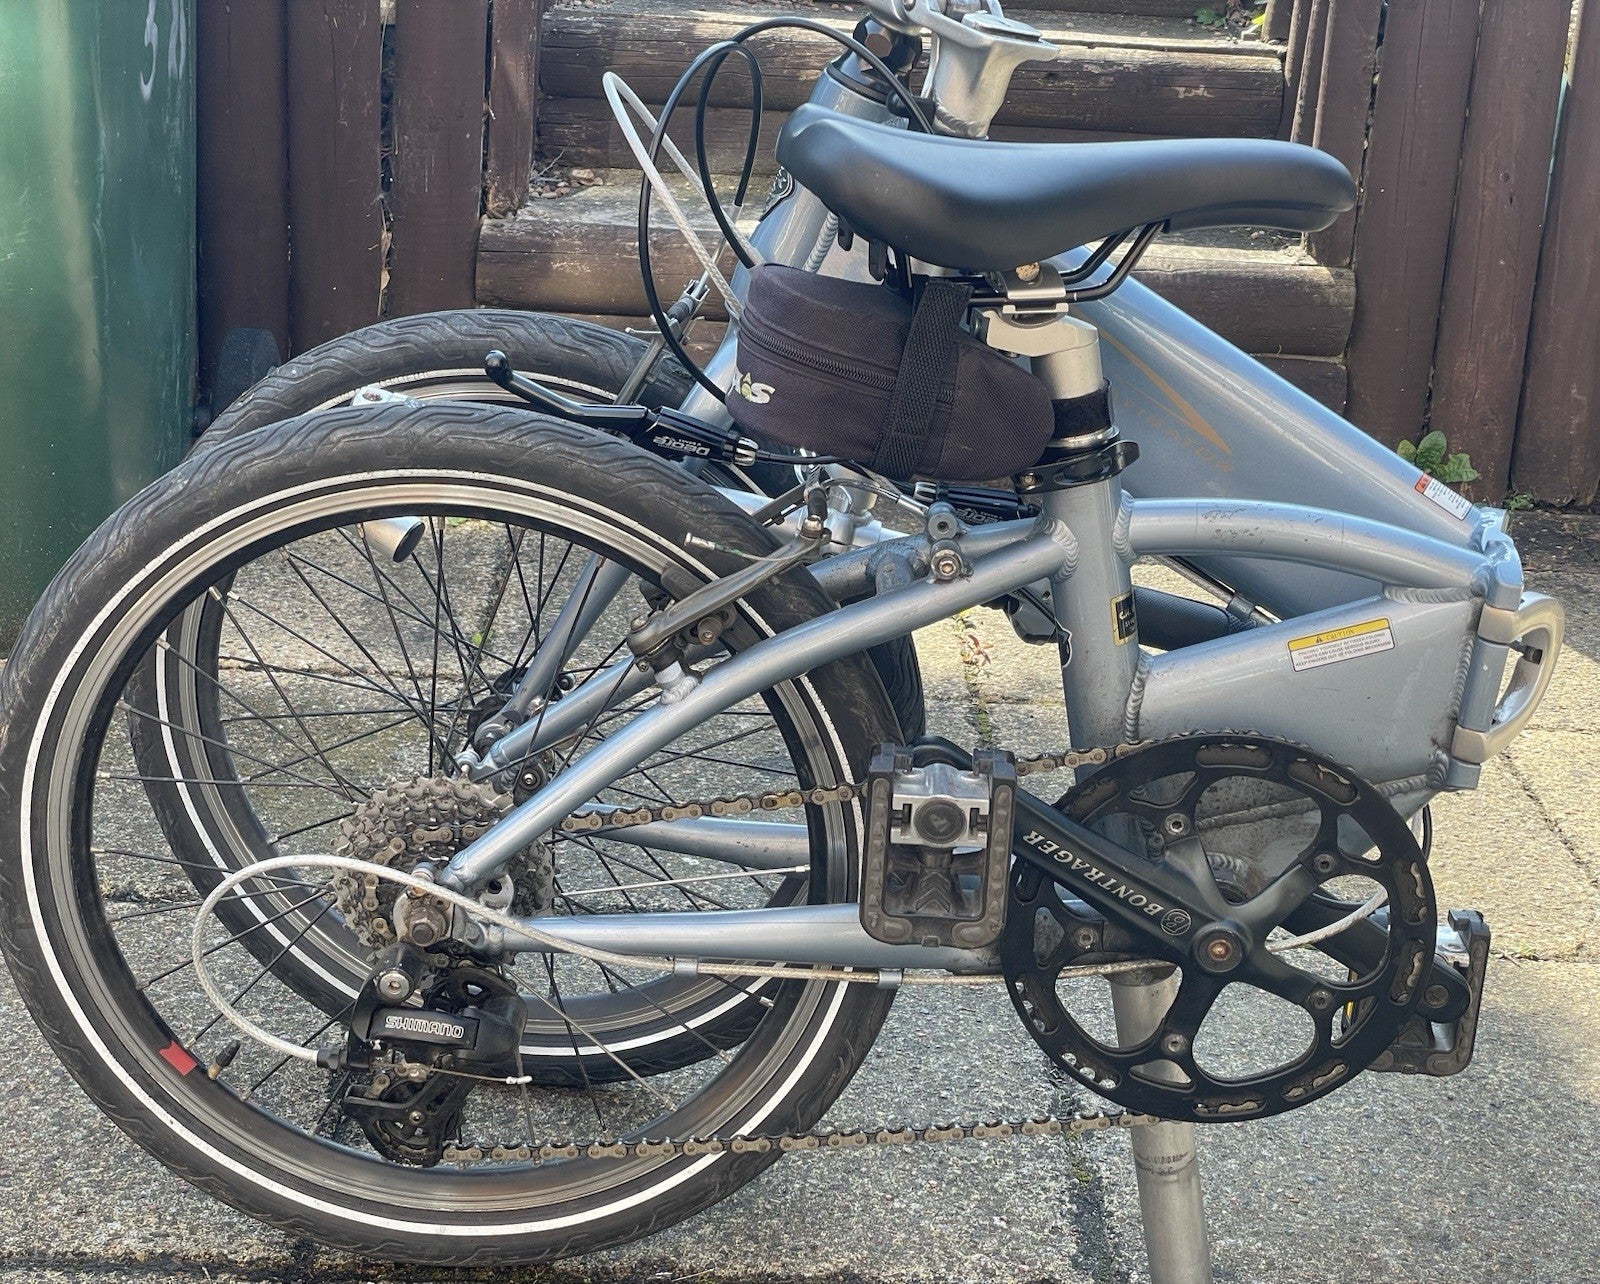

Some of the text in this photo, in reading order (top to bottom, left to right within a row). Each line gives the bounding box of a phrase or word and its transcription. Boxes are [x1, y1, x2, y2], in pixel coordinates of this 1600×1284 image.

[1327, 630, 1354, 640] CAUTION
[1022, 830, 1165, 916] BONTRAGER
[384, 1015, 465, 1039] SHIMANO
